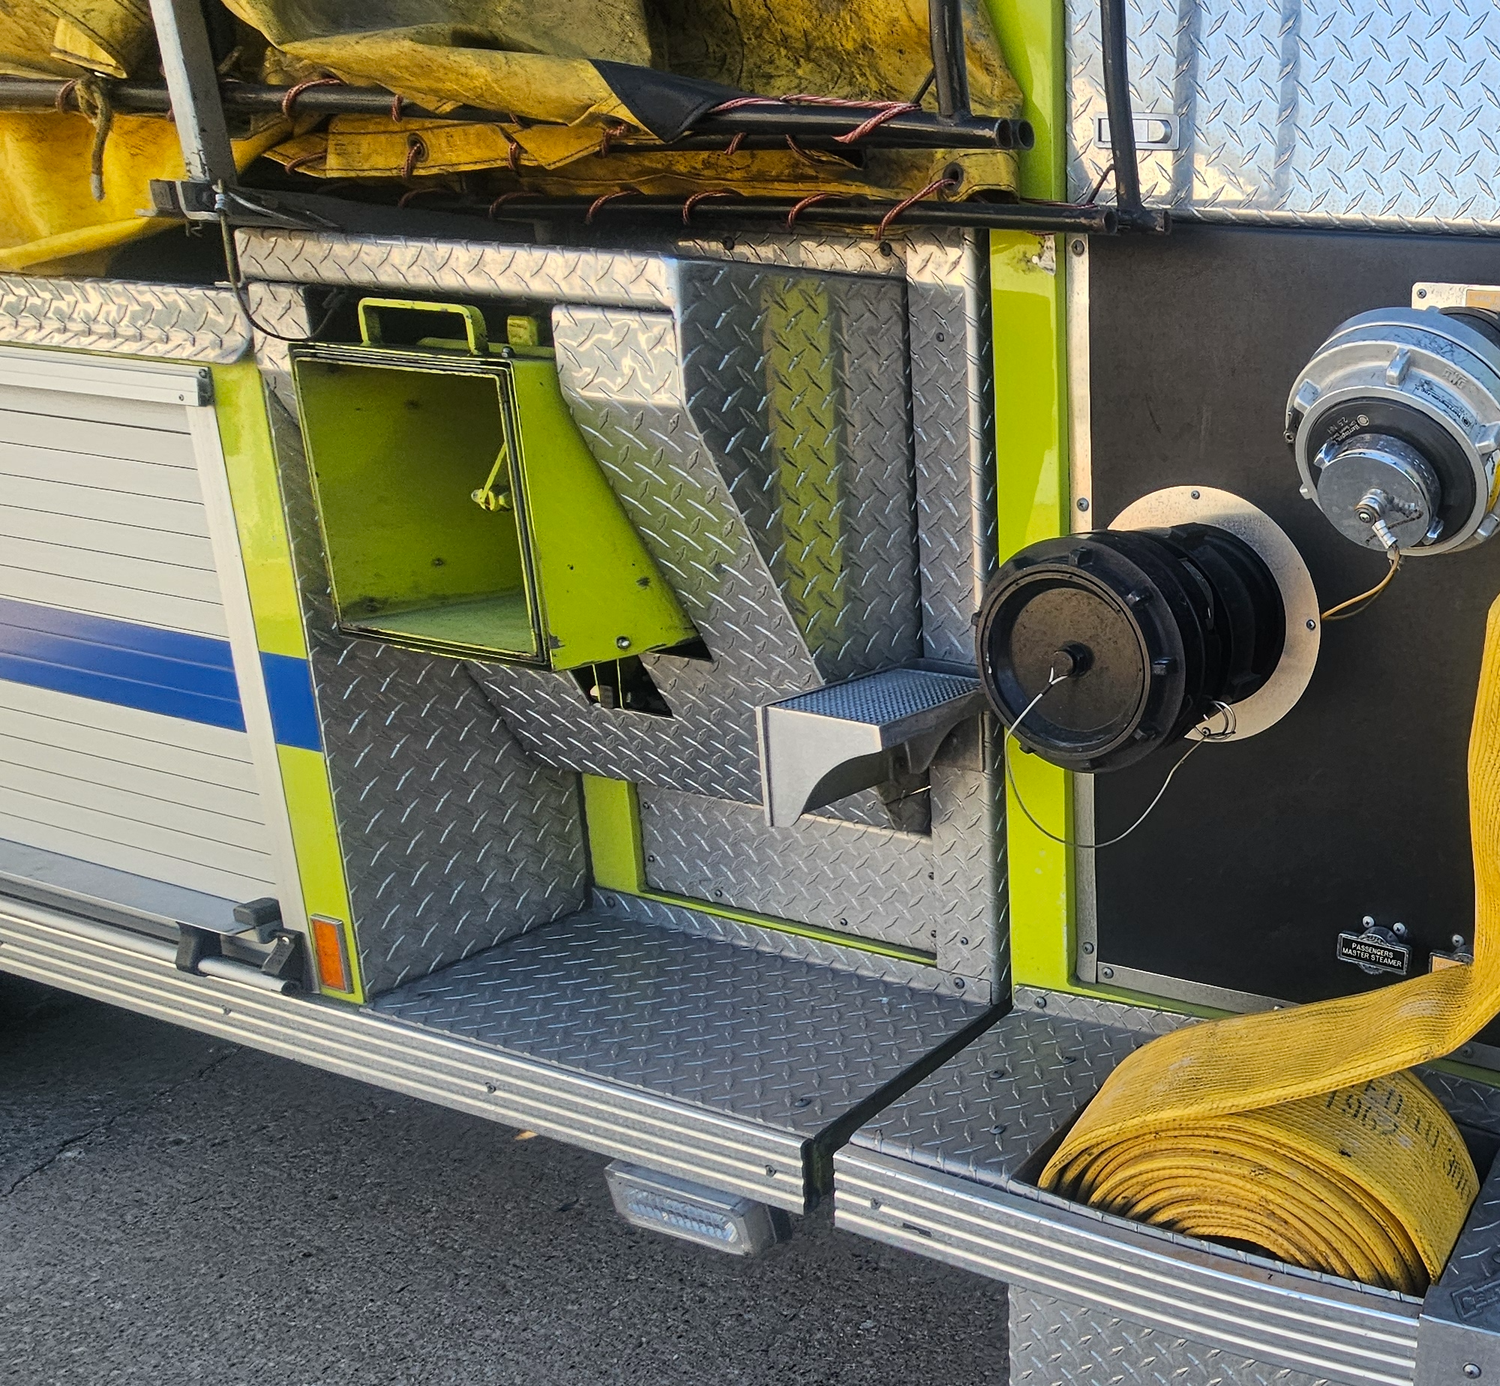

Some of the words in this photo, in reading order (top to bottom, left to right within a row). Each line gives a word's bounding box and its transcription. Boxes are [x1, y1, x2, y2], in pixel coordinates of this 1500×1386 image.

[1342, 947, 1369, 959] MASTER
[1370, 954, 1402, 968] STEAMER
[1351, 942, 1394, 959] PASSENGERS
